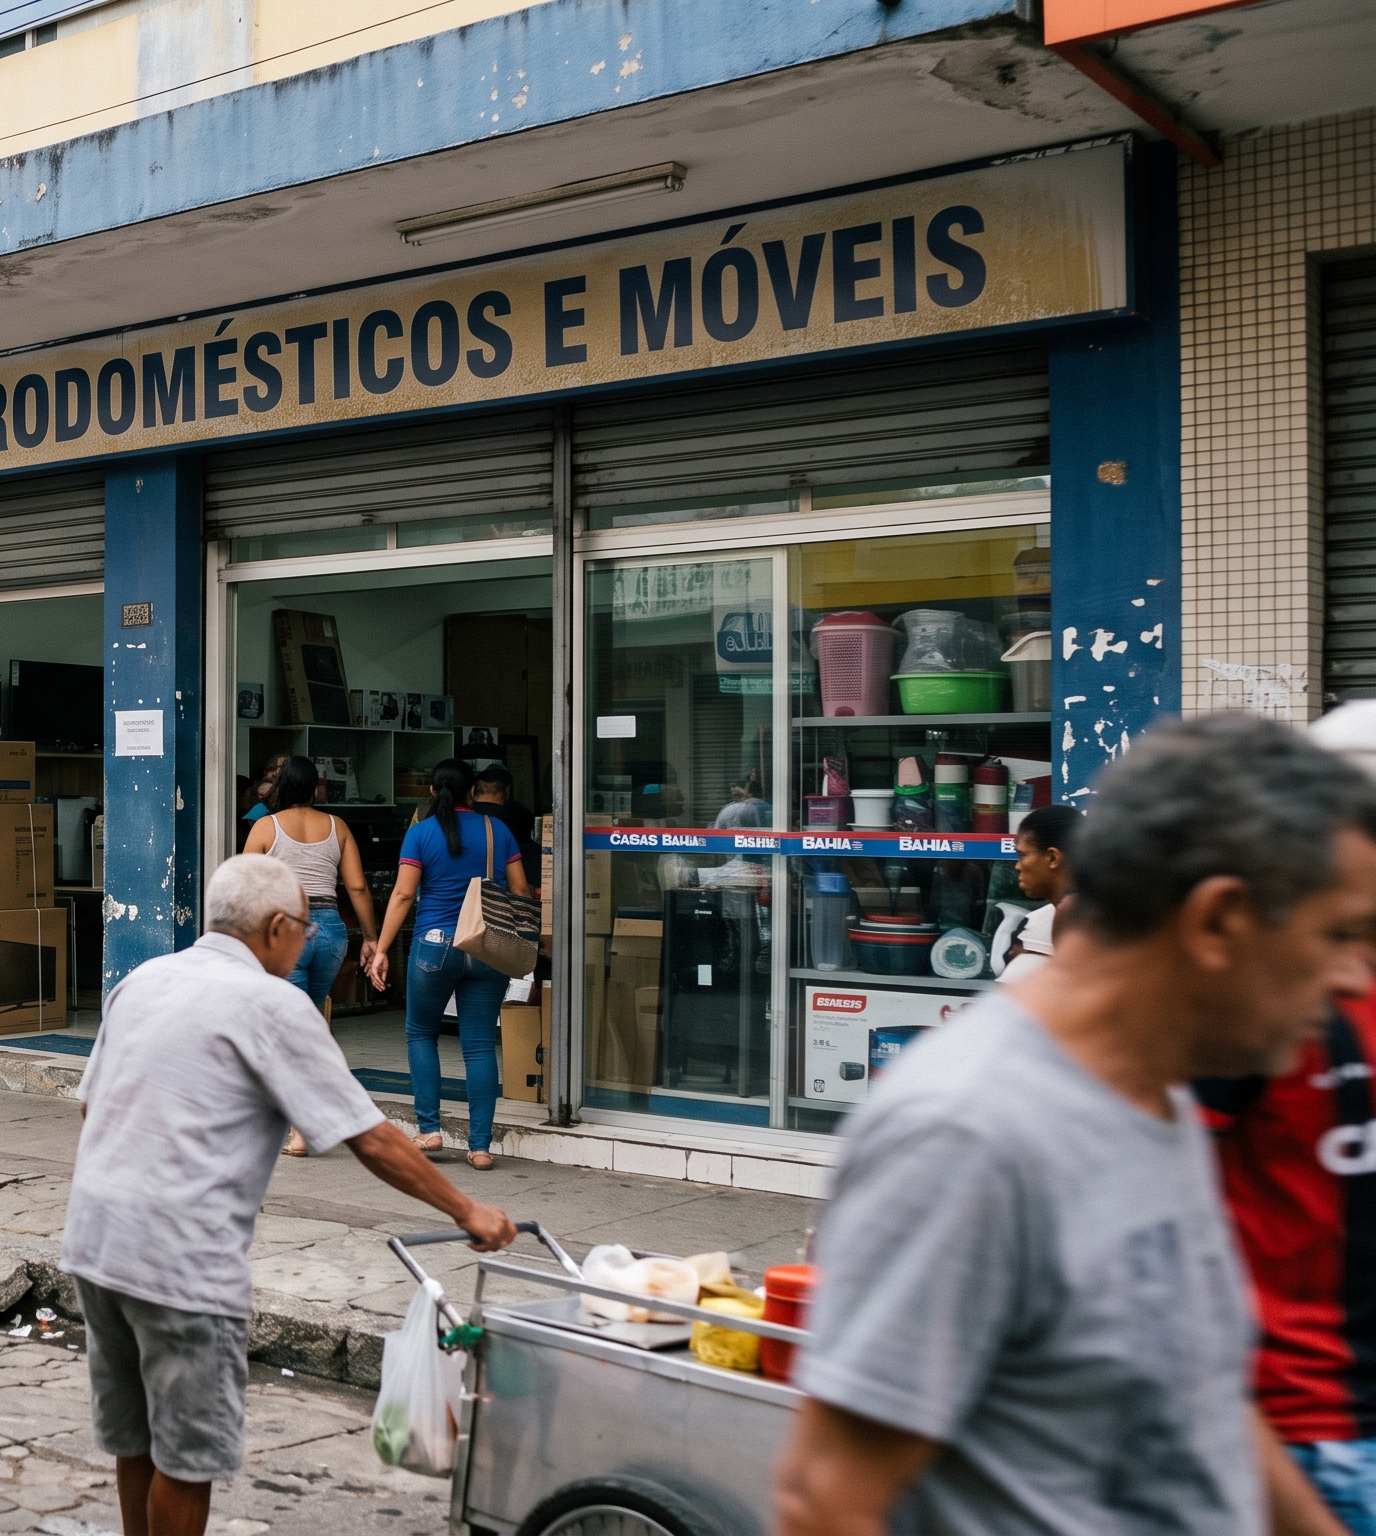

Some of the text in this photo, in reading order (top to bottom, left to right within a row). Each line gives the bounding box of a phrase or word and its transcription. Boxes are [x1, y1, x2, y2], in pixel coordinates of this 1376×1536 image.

[544, 275, 588, 368] E
[618, 205, 987, 357] MÓVEIS
[802, 836, 952, 852] BAHIA BAHIA
